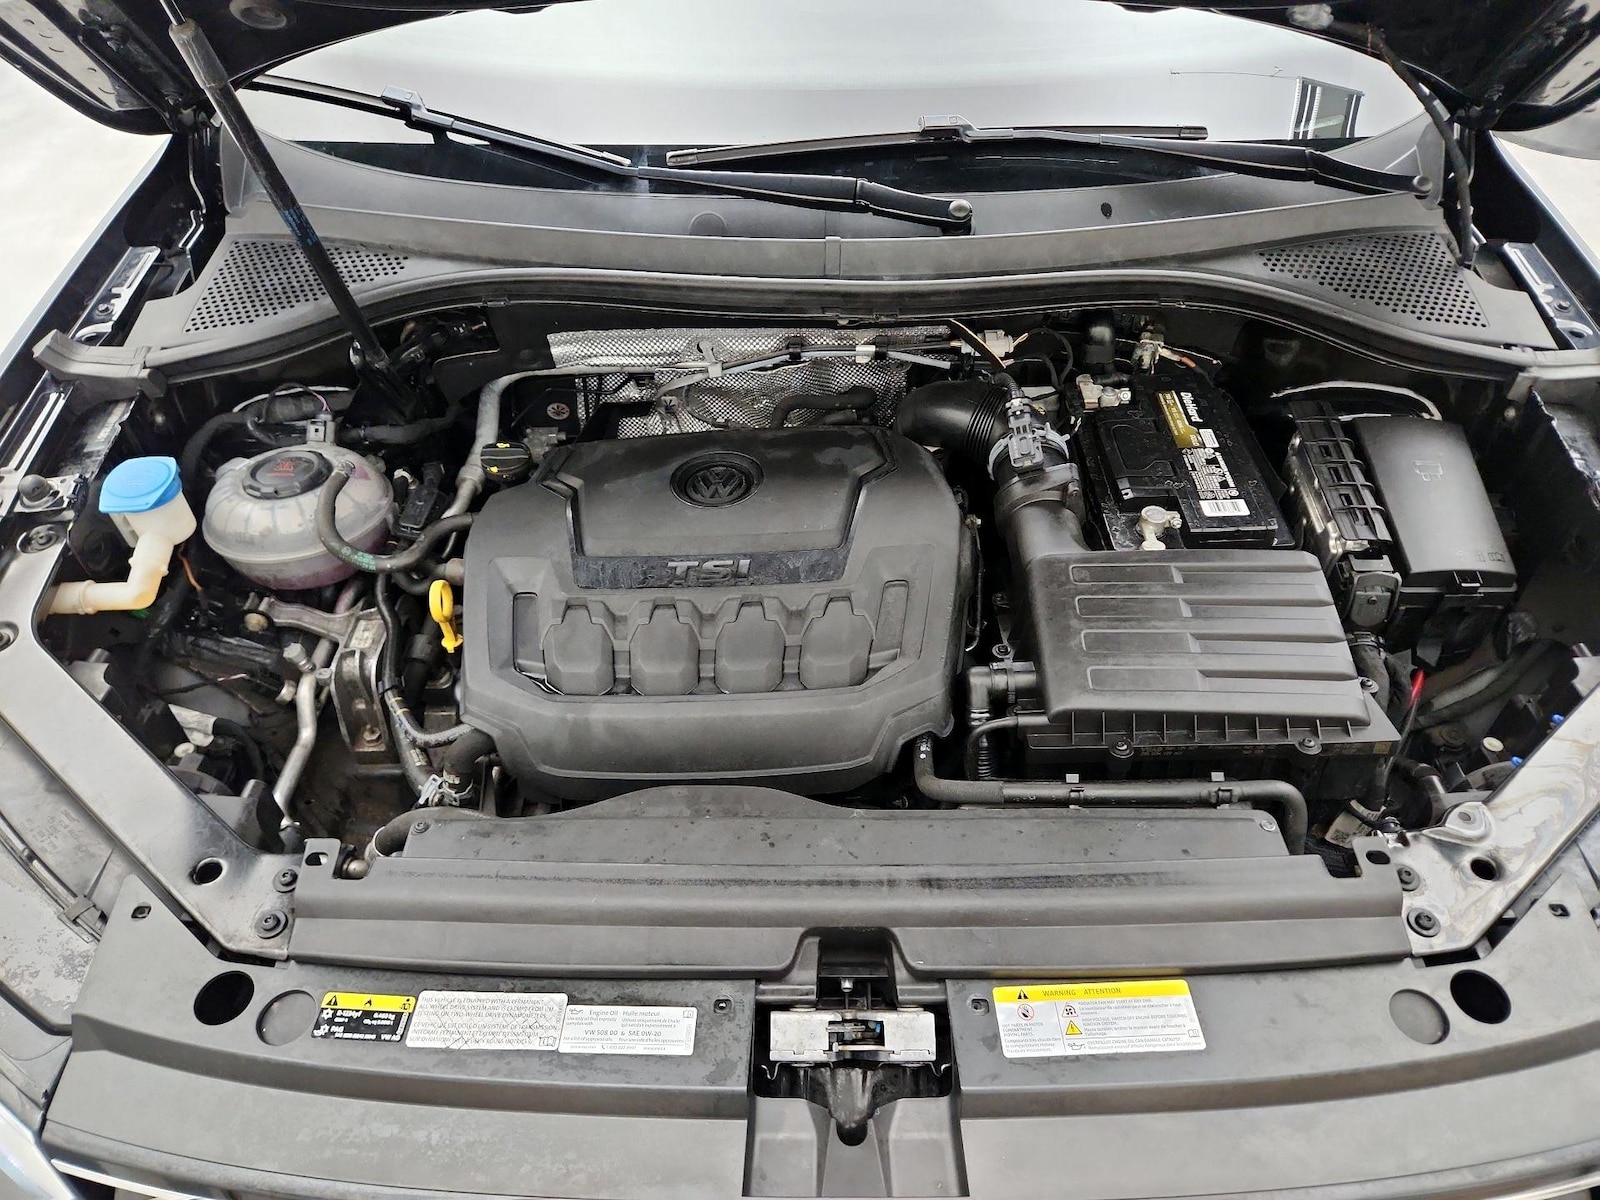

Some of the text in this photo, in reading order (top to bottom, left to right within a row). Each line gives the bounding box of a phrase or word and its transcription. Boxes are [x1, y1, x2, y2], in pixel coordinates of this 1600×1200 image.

[1180, 392, 1203, 422] DieHard
[667, 560, 751, 583] TSI
[1084, 987, 1122, 996] ATTENTION
